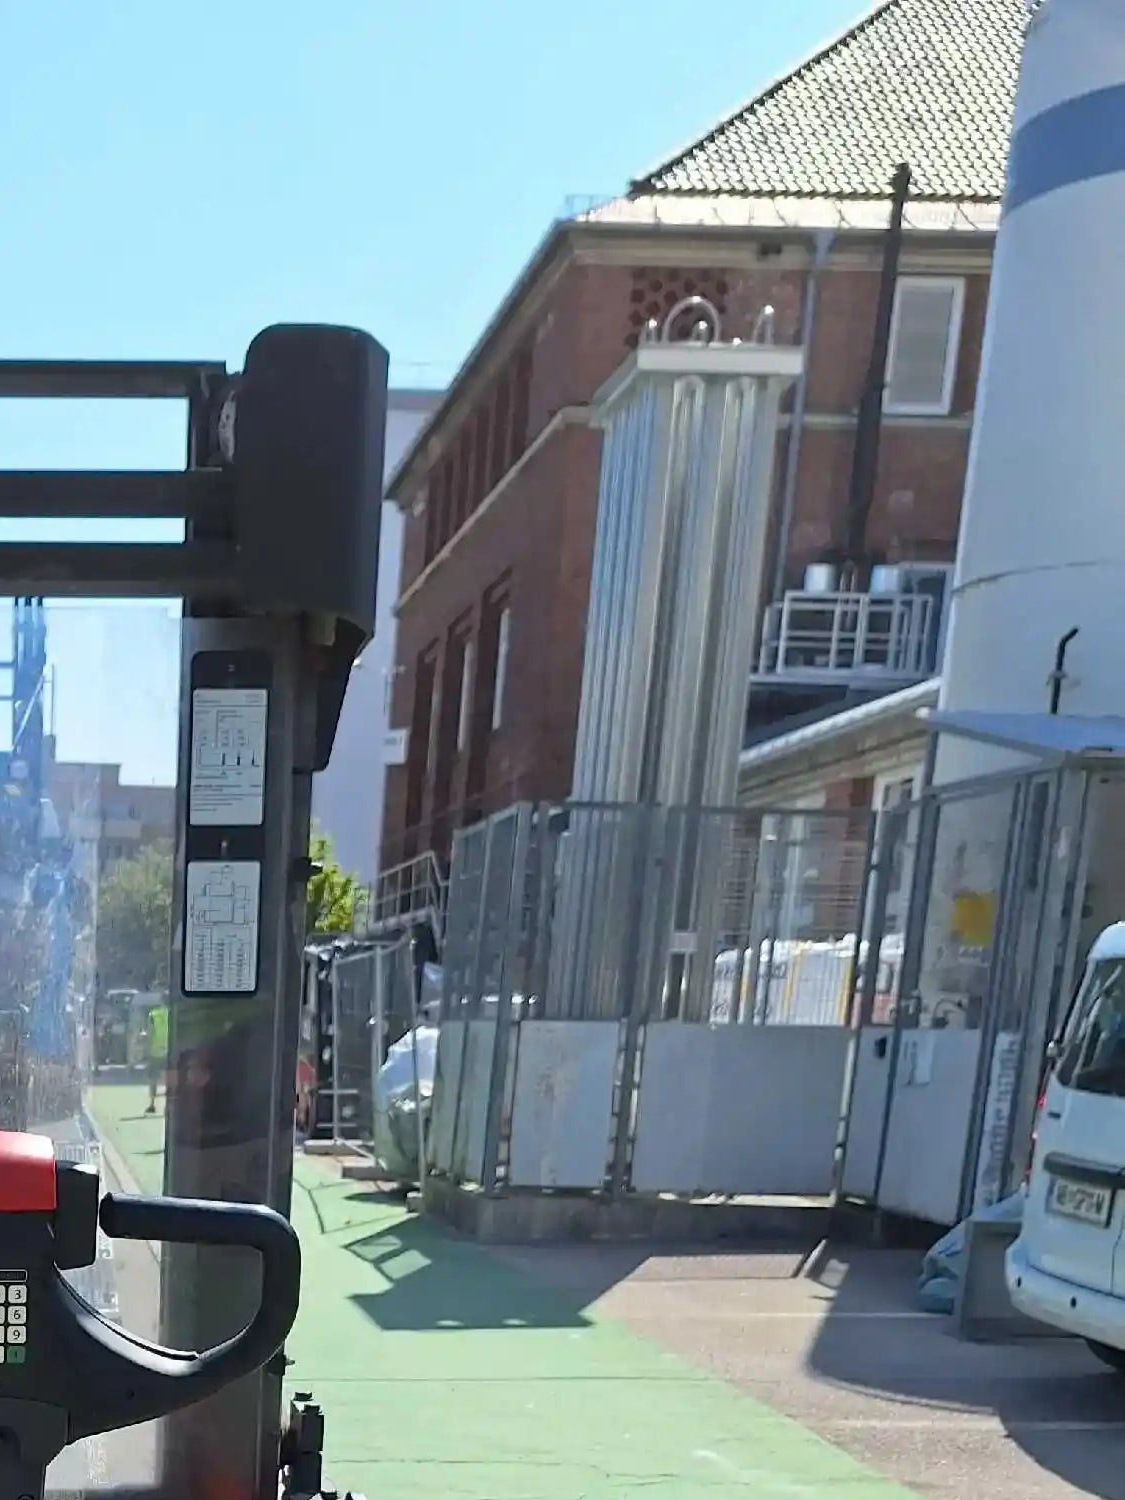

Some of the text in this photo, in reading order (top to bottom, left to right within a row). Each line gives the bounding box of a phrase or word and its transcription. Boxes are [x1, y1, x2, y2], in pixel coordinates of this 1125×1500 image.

[14, 1289, 21, 1300] 3
[13, 1310, 21, 1320] 6
[13, 1330, 21, 1340] 9
